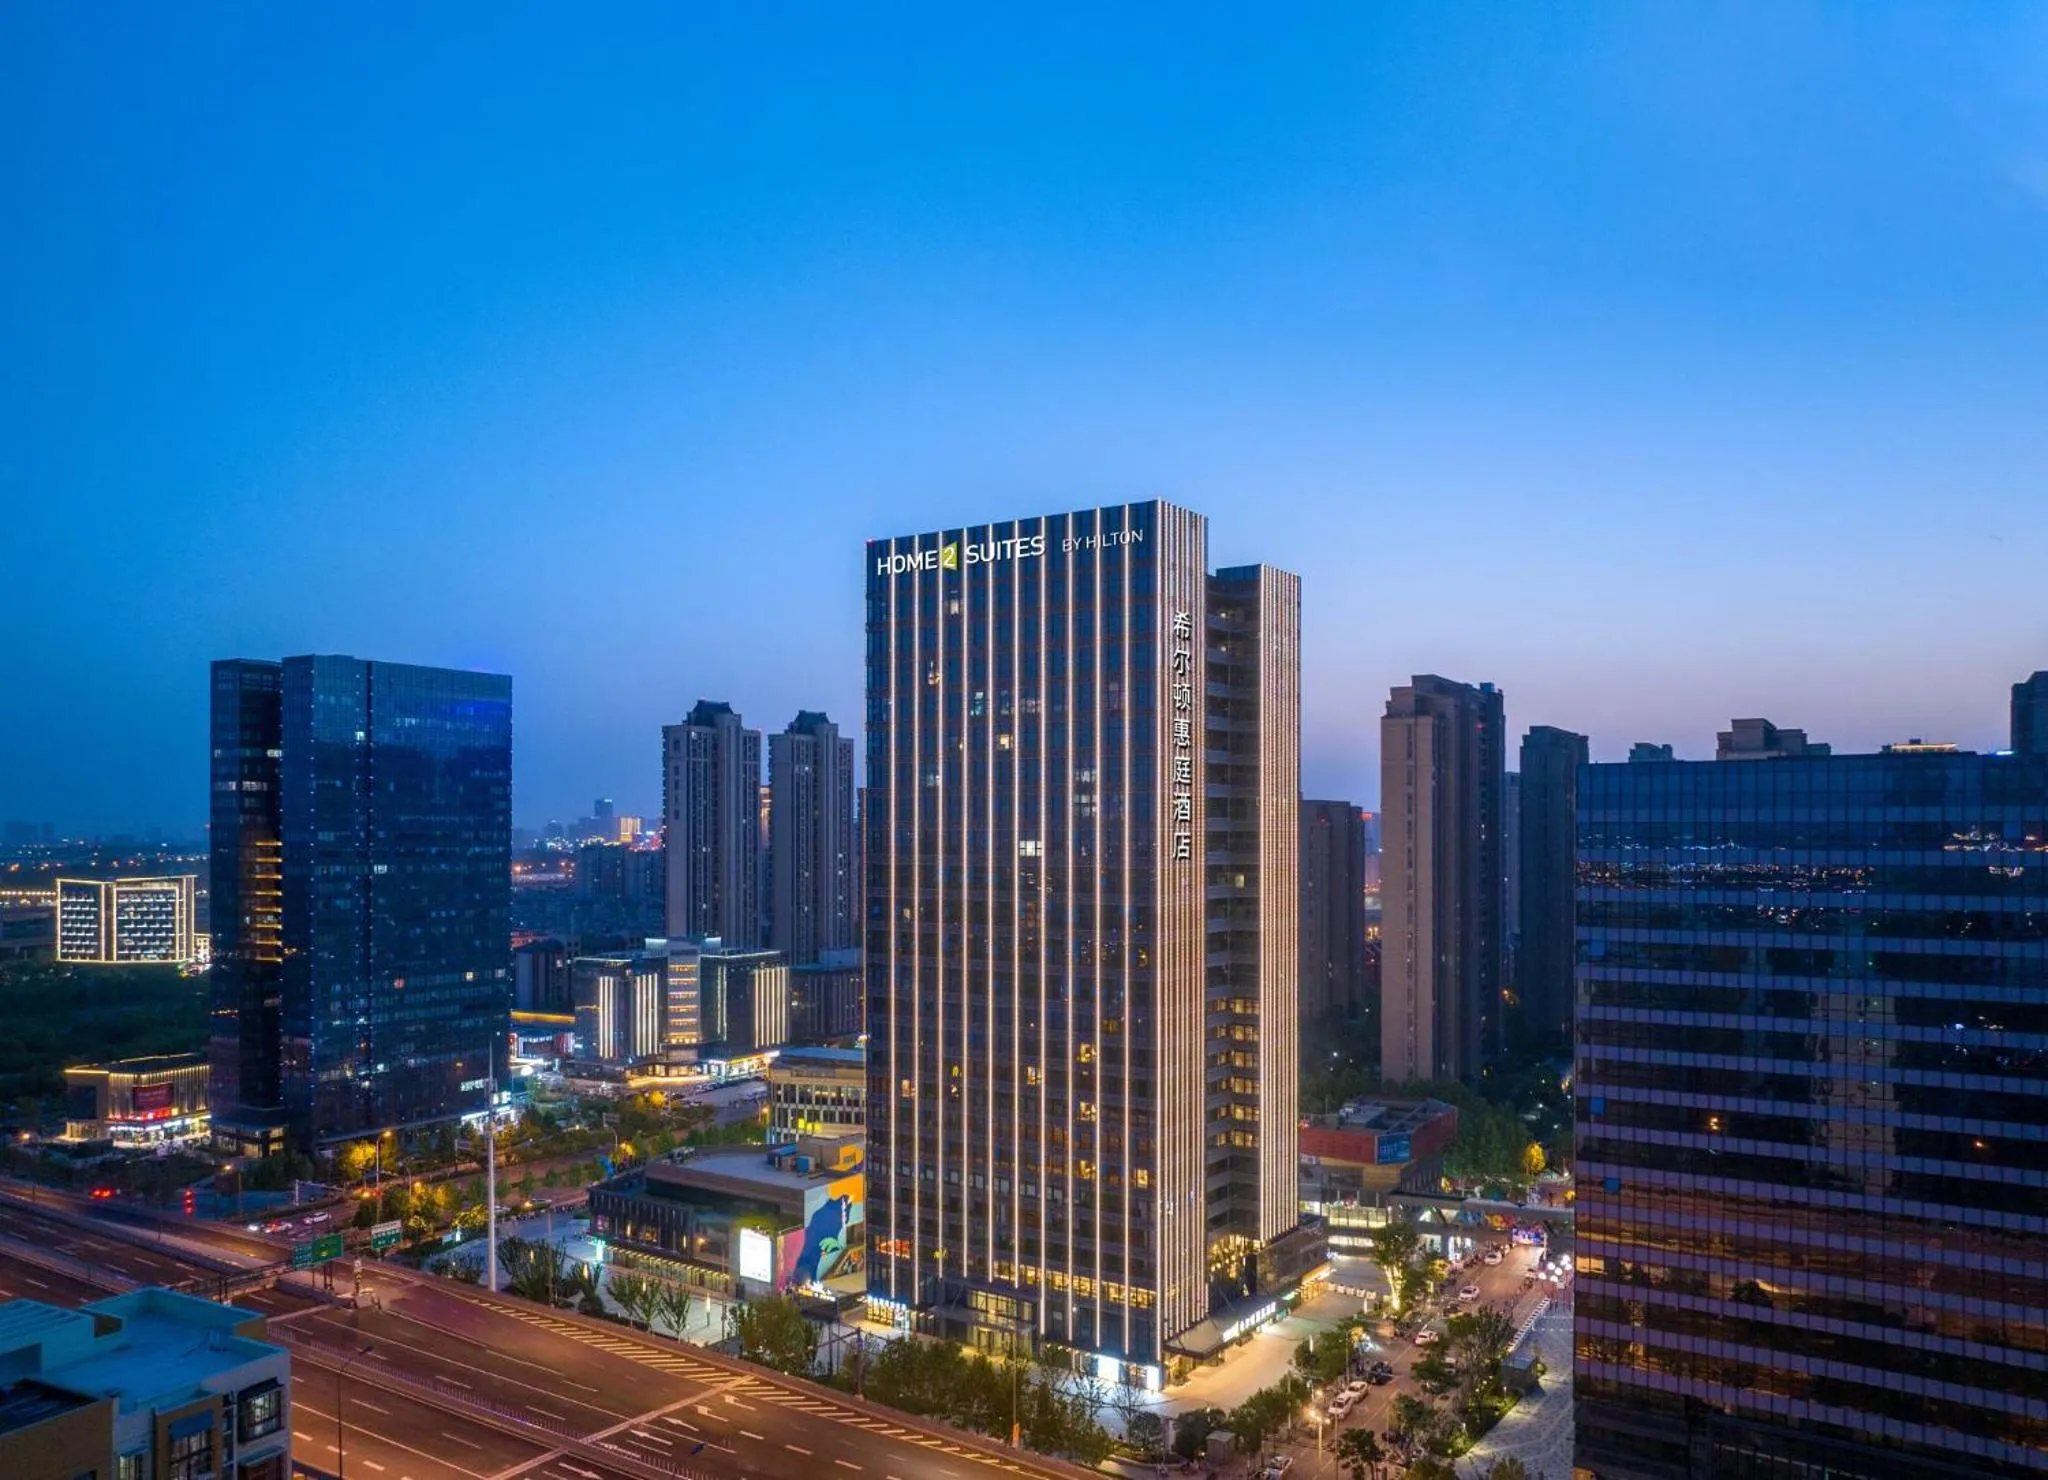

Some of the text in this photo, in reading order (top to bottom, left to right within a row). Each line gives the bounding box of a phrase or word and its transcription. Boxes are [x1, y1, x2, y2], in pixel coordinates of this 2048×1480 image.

[966, 535, 1046, 564] SUITES
[1062, 537, 1082, 552] BY
[1086, 529, 1143, 549] HILTON
[1173, 611, 1191, 858] 希尔顿惠庭酒店
